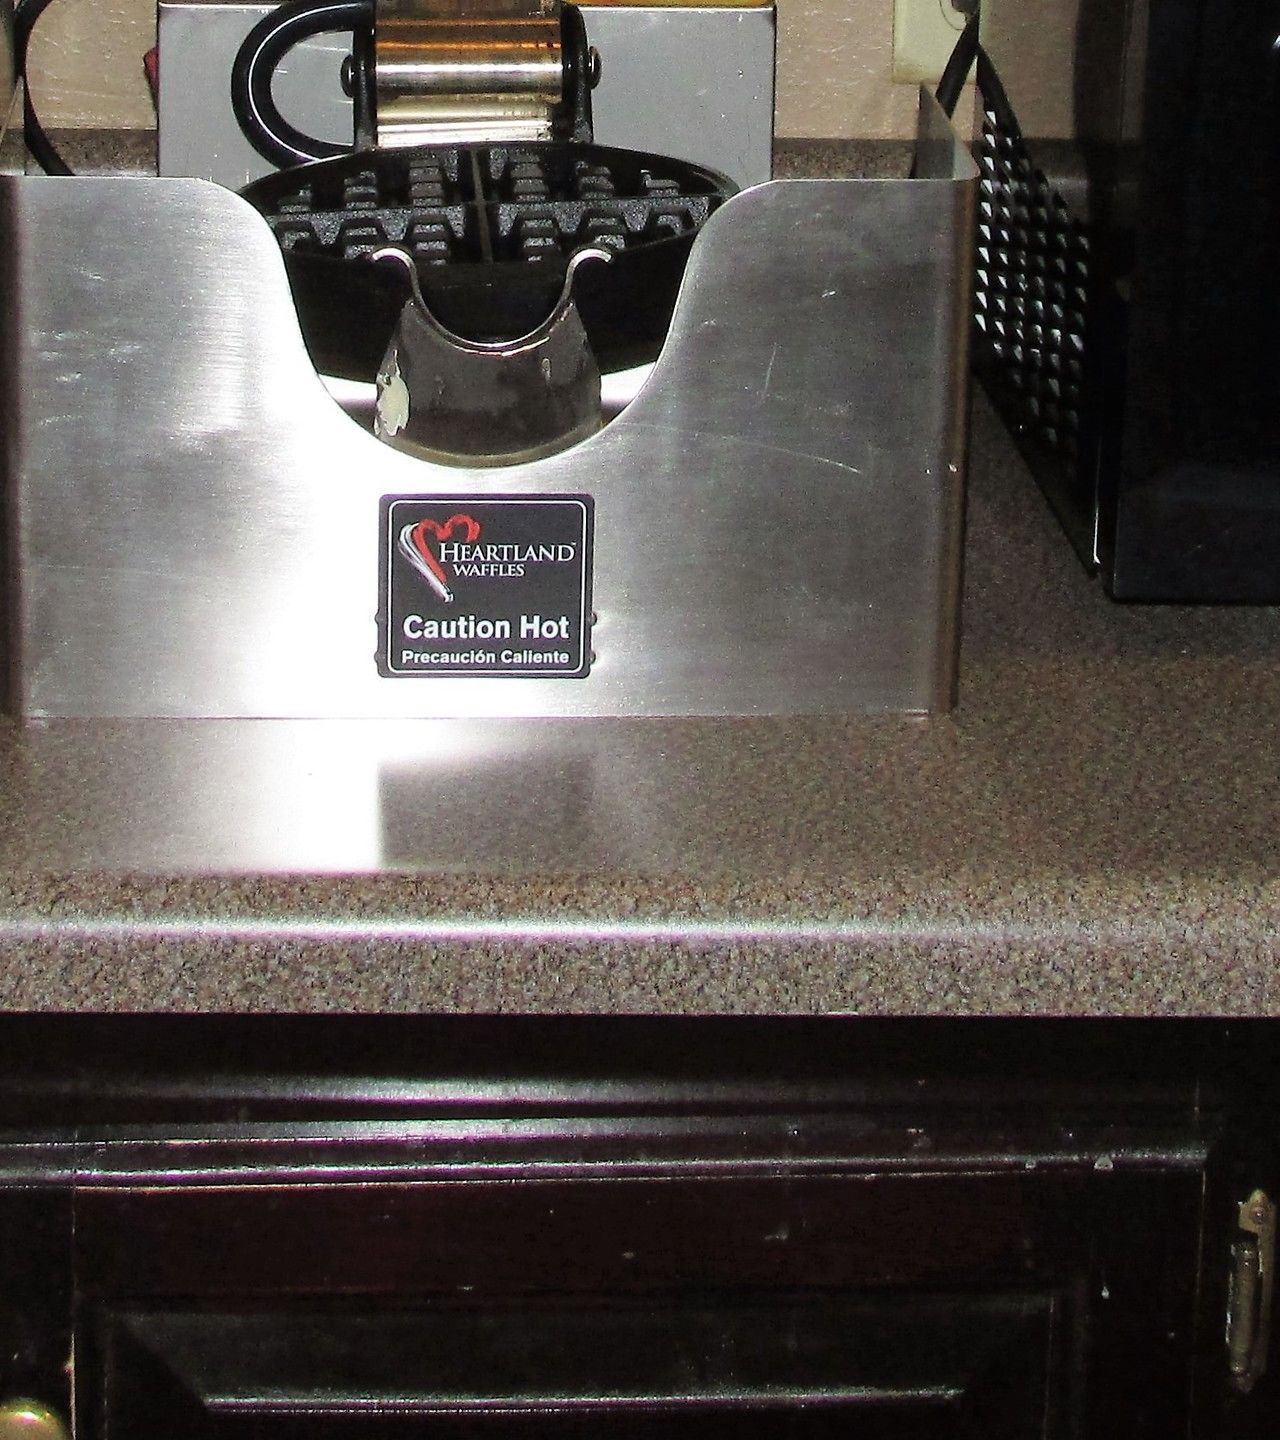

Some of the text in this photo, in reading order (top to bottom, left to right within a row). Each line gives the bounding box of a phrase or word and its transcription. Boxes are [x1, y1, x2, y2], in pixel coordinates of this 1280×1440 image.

[439, 542, 576, 562] HEARTLAND
[452, 563, 525, 577] WAFFLES
[402, 614, 570, 640] Caution Hot
[401, 648, 570, 665] Precaución Caliente
